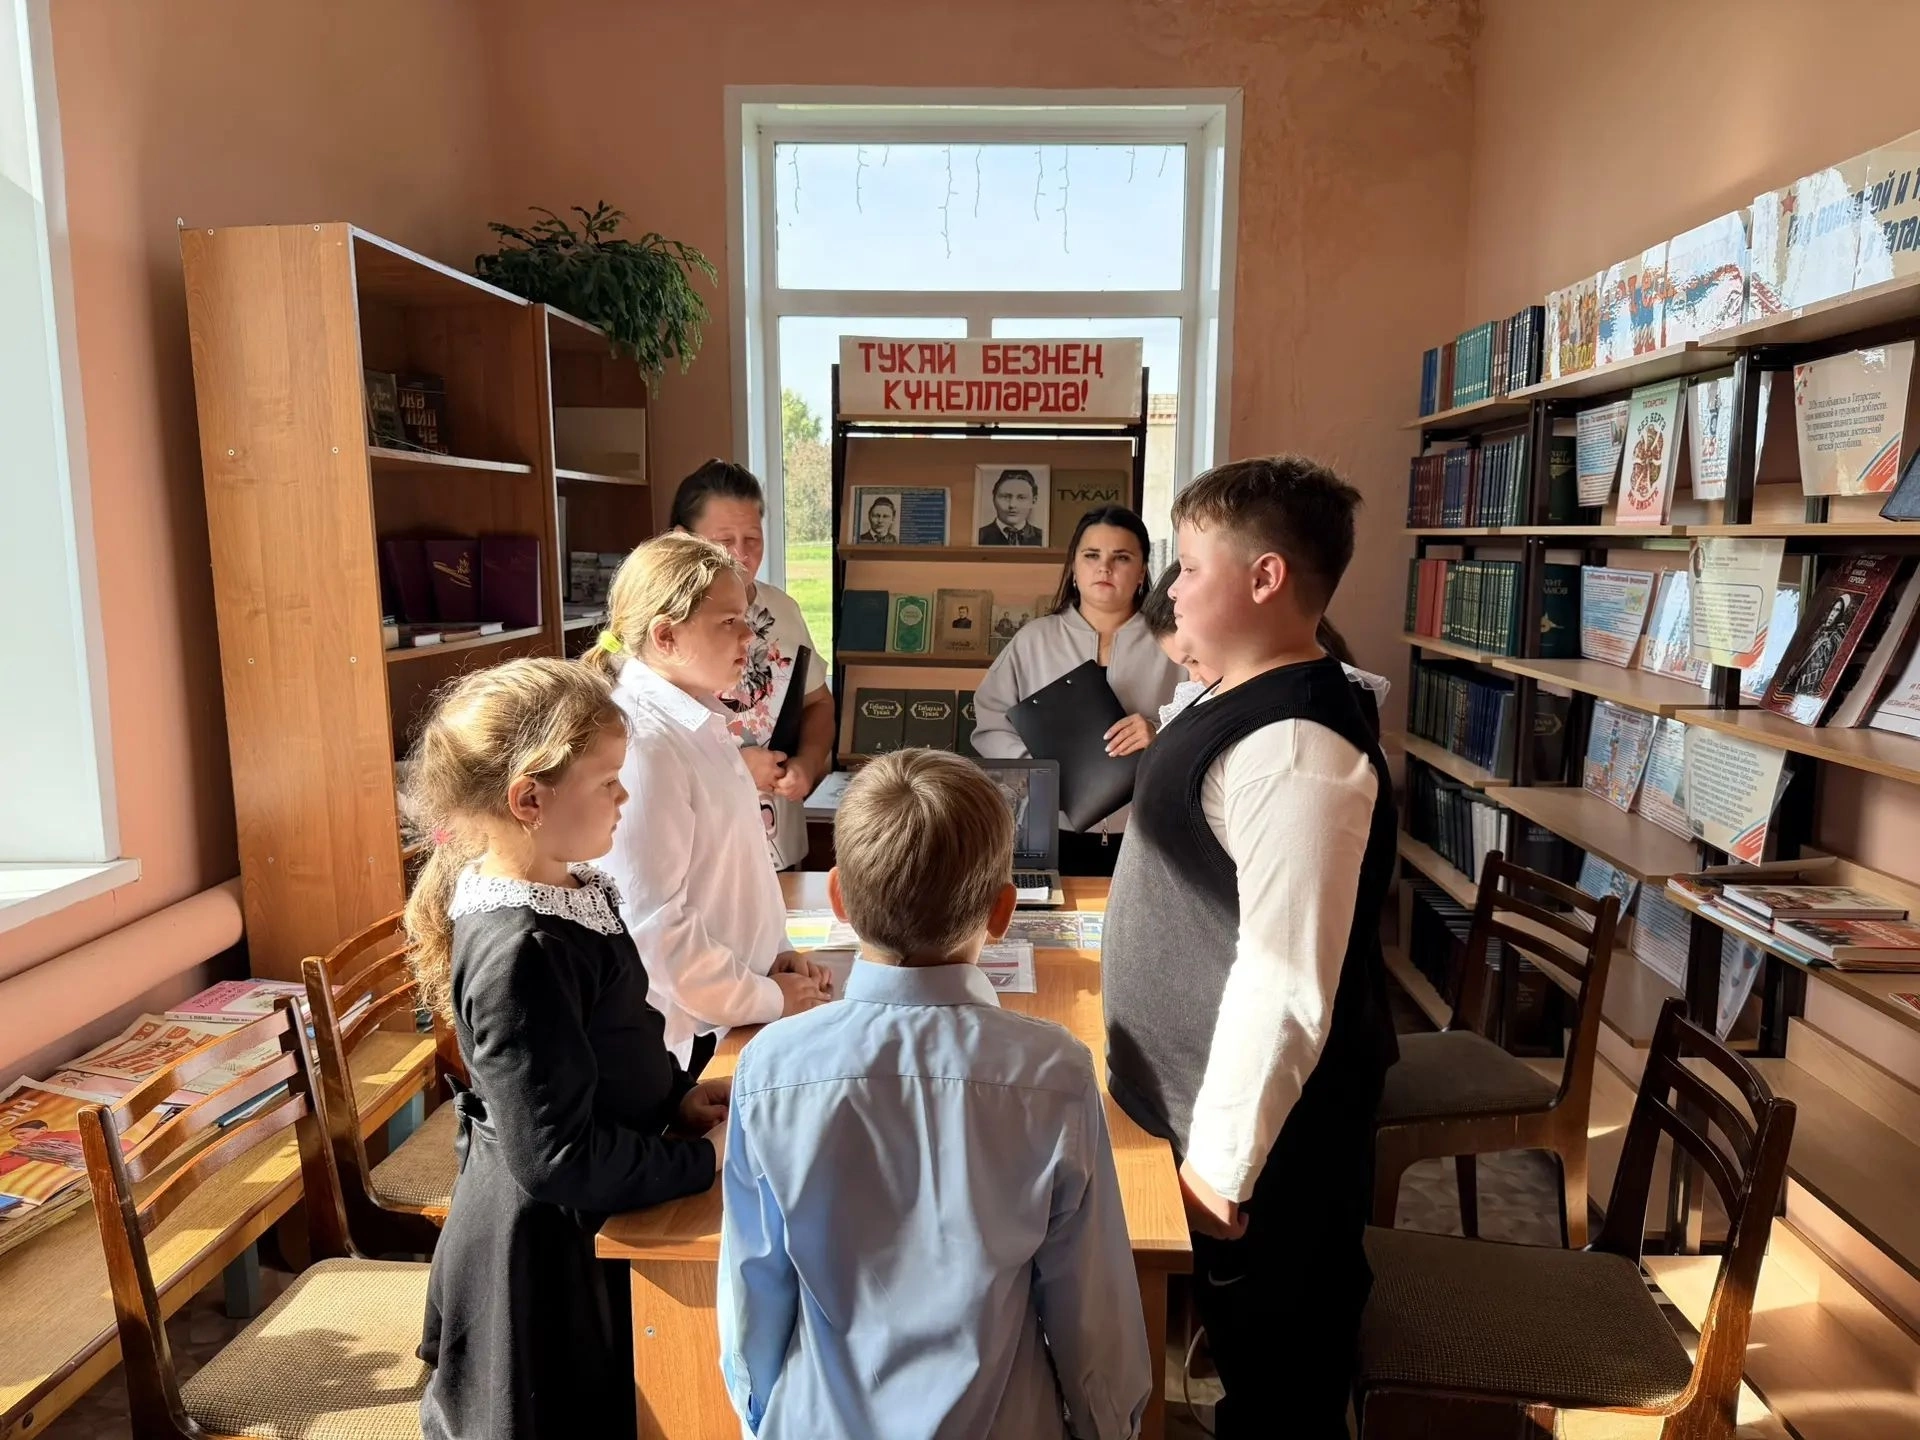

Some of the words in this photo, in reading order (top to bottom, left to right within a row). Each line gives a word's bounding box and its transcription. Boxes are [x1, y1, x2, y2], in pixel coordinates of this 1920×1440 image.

[858, 341, 956, 374] ТУКАЙ
[982, 344, 1104, 378] БЕЗНЕҢ
[1057, 488, 1120, 501] ТУКАЙ
